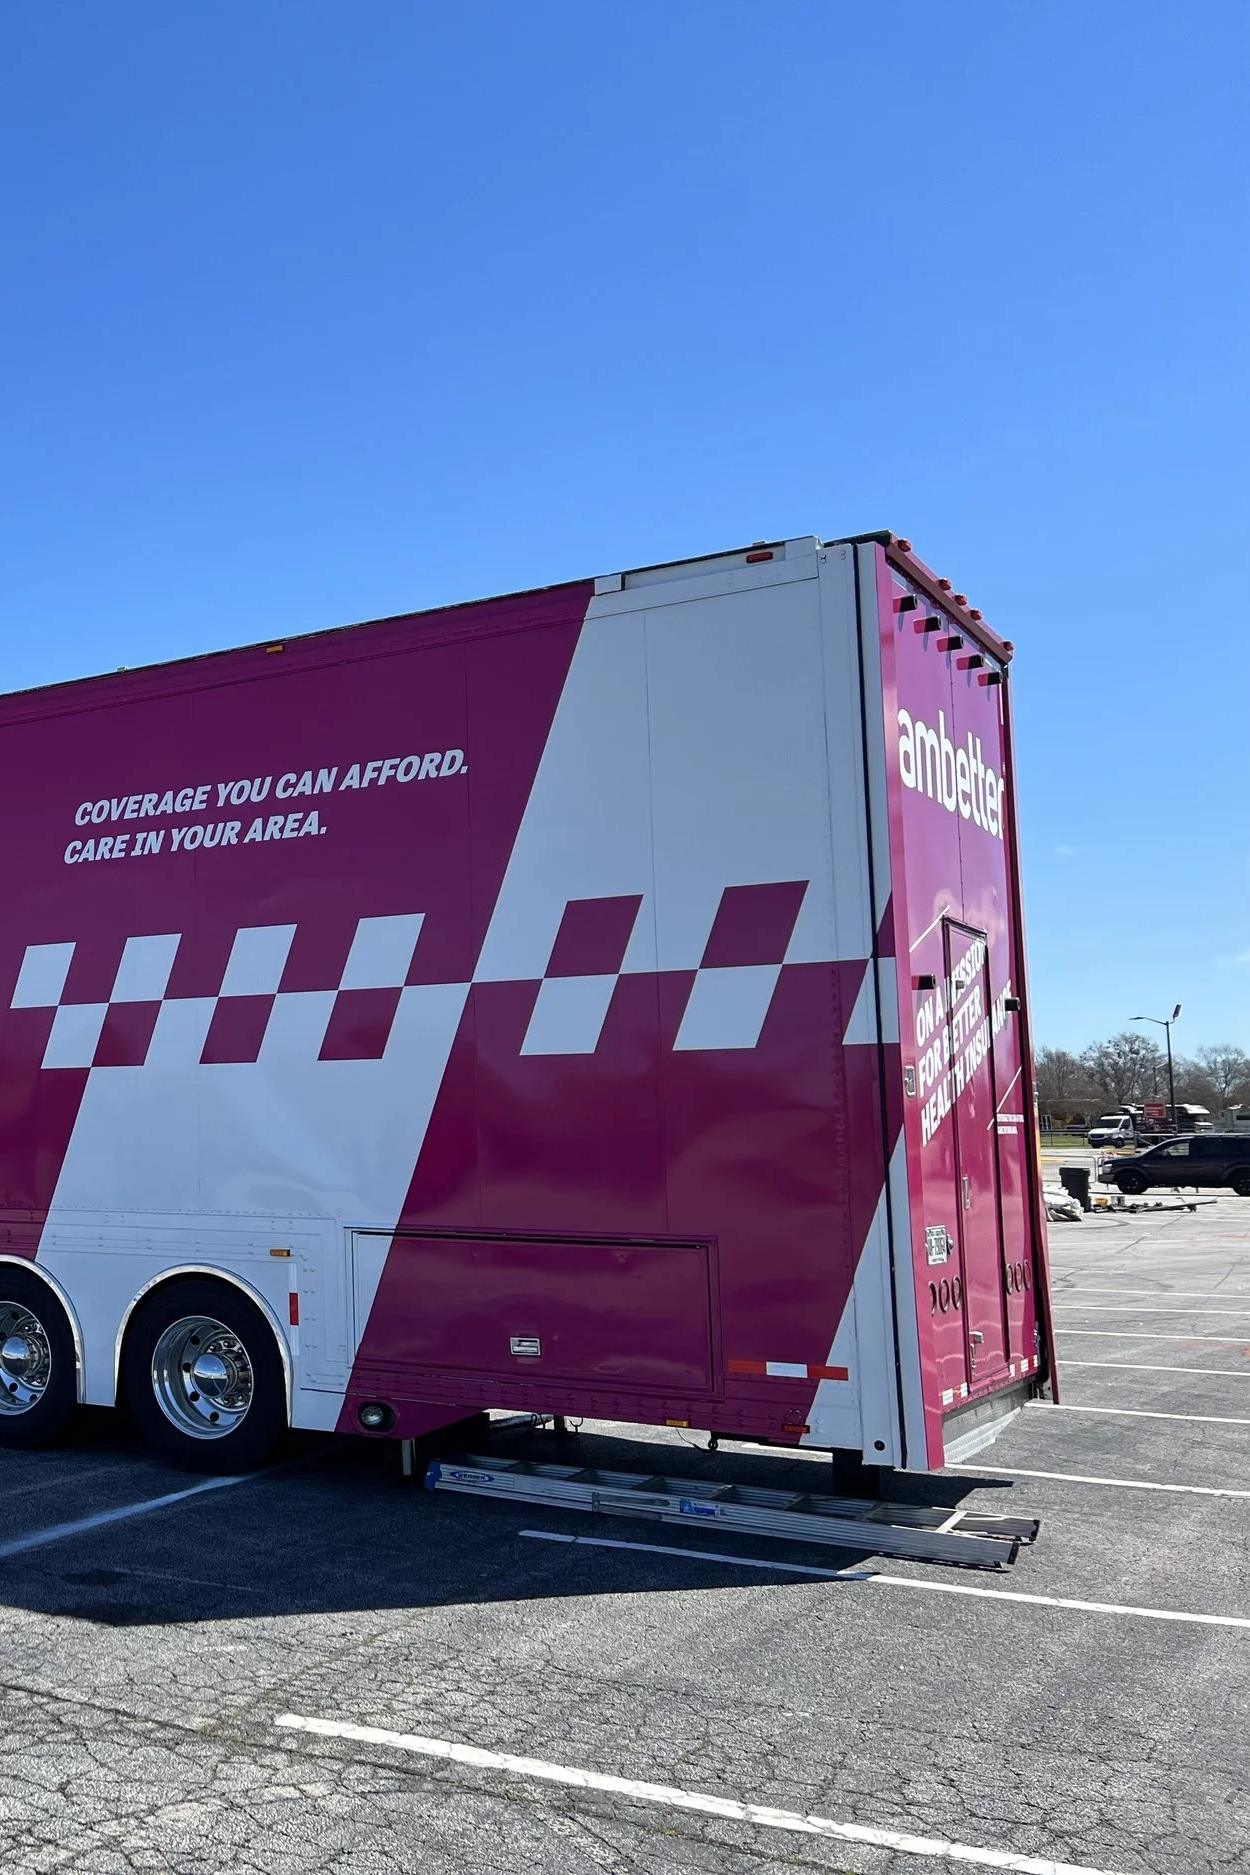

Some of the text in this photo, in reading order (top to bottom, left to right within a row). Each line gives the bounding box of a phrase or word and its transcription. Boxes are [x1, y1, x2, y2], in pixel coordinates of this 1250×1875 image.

[74, 749, 469, 826] COVERAGE YOU CAN AFFORD.
[897, 708, 1004, 840] ambetter
[63, 811, 328, 865] CARE IN YOUR AREA.
[917, 996, 934, 1047] ON
[936, 986, 944, 1026] A
[918, 1038, 942, 1098] FOR
[921, 1056, 964, 1147] HEALTH
